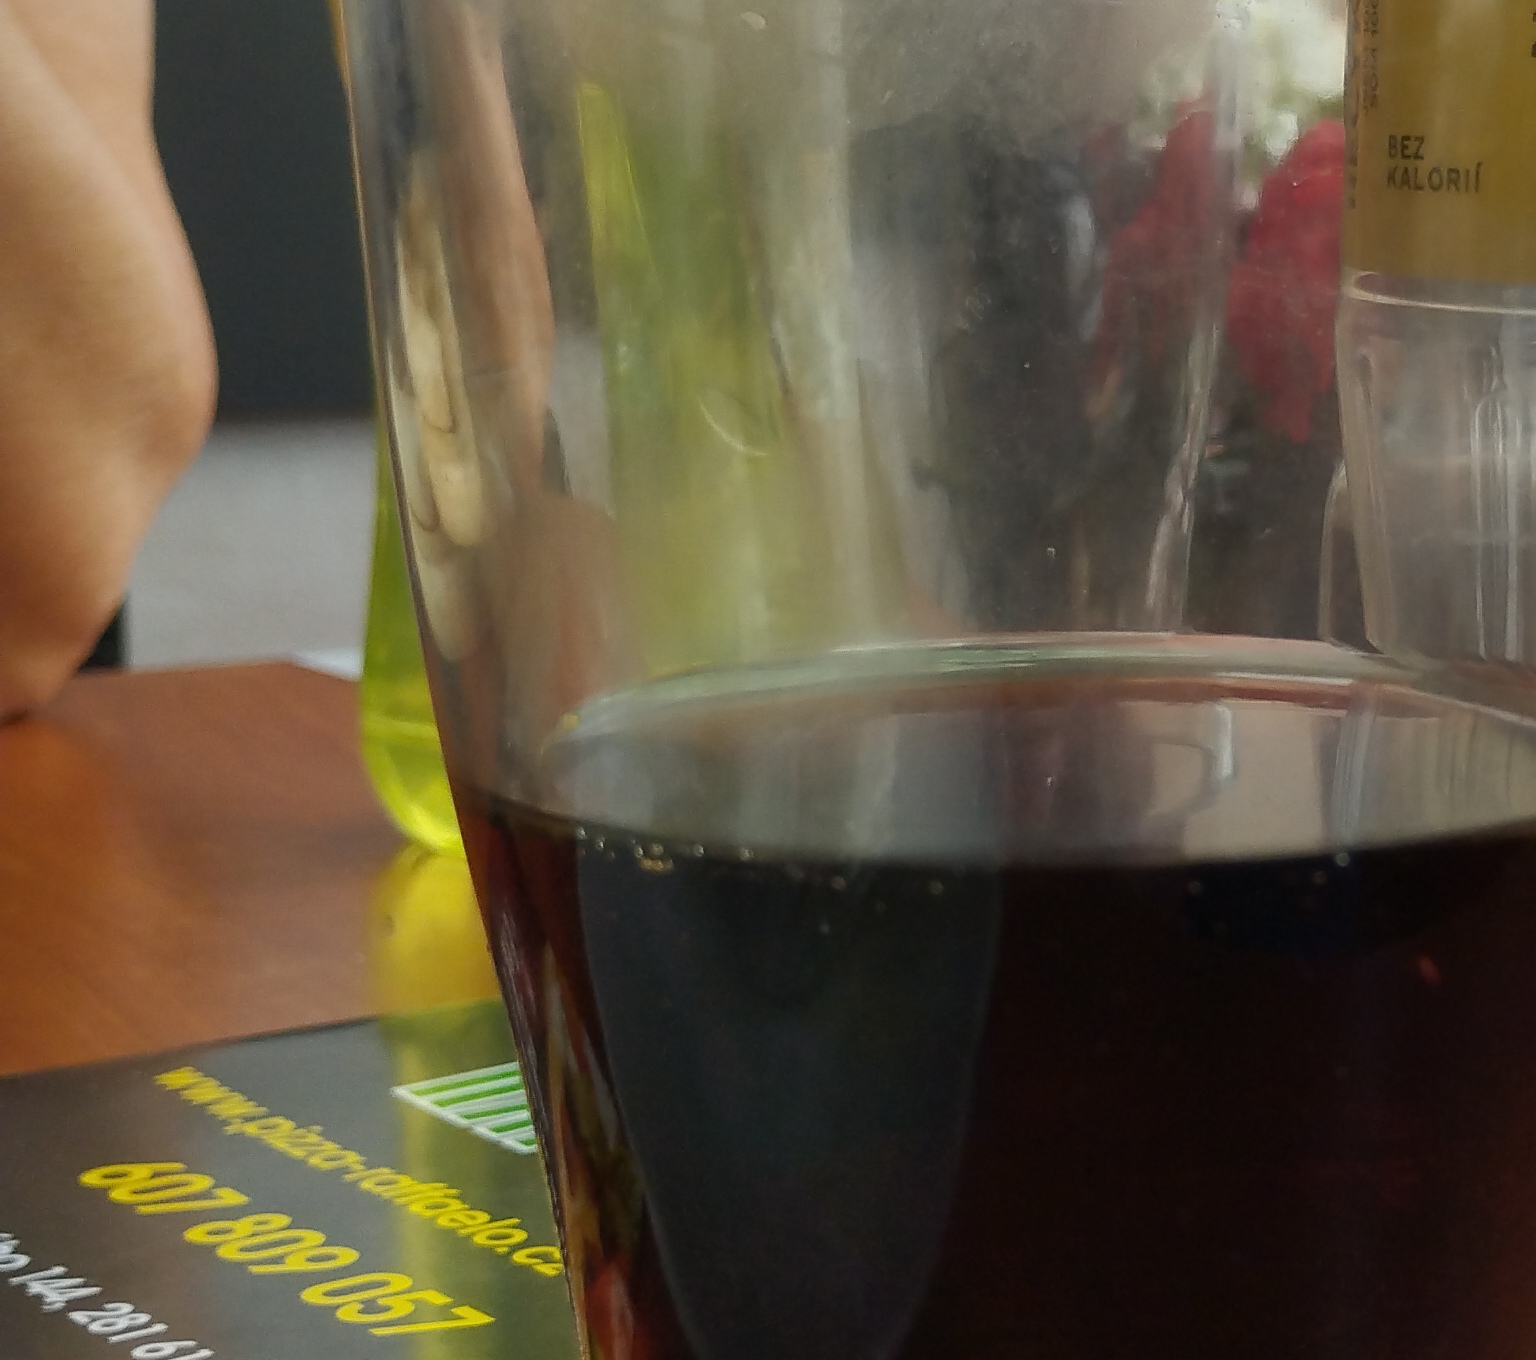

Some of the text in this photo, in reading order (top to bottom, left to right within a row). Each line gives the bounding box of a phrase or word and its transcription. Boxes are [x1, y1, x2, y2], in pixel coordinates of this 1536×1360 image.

[1386, 134, 1426, 161] BEZ
[1385, 161, 1484, 195] KALORIÍ
[78, 1161, 497, 1337] 607 809 057
[66, 1301, 170, 1345] 281
